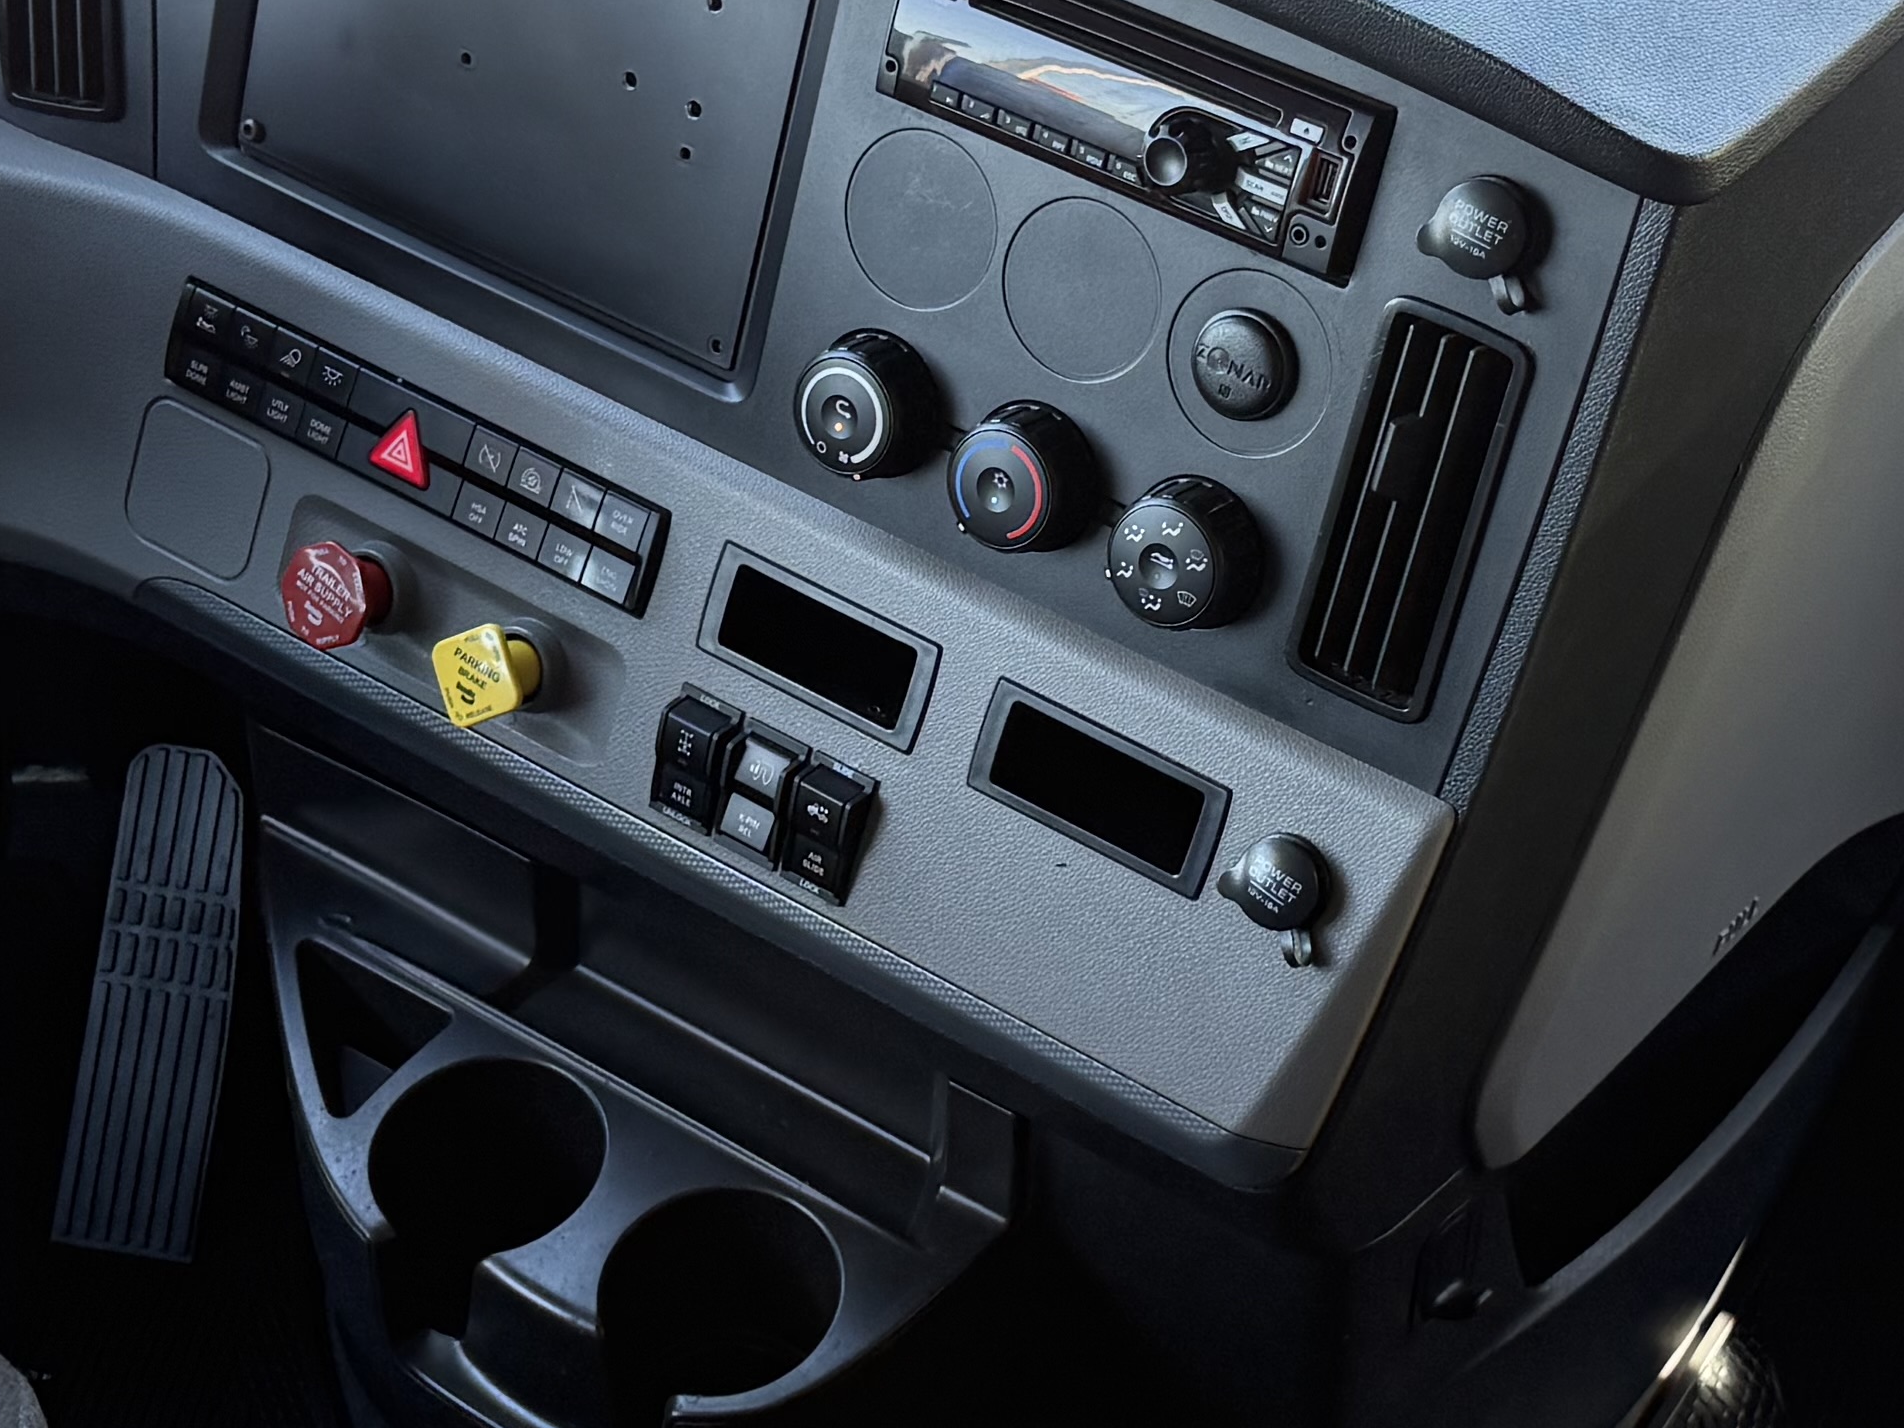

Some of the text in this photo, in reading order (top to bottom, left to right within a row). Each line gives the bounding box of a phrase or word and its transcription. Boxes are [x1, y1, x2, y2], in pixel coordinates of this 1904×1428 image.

[1455, 199, 1509, 234] POWER
[1449, 212, 1503, 245] OUTLET
[266, 408, 288, 423] LIGHT
[307, 429, 328, 444] LIGHT
[297, 568, 314, 586] AIR
[314, 582, 353, 618] SUPPLY
[312, 564, 351, 602] TRAILER
[454, 647, 501, 683] PARKING
[458, 666, 488, 690] BRAKE
[700, 694, 721, 710] LOCK
[671, 791, 691, 808] AXLE
[663, 807, 691, 826] UNLOCK
[802, 859, 824, 877] SLIDE
[808, 851, 823, 865] AIR
[1249, 866, 1296, 903] OUTLET
[1256, 855, 1303, 894] POWER
[799, 878, 821, 895] LOCK
